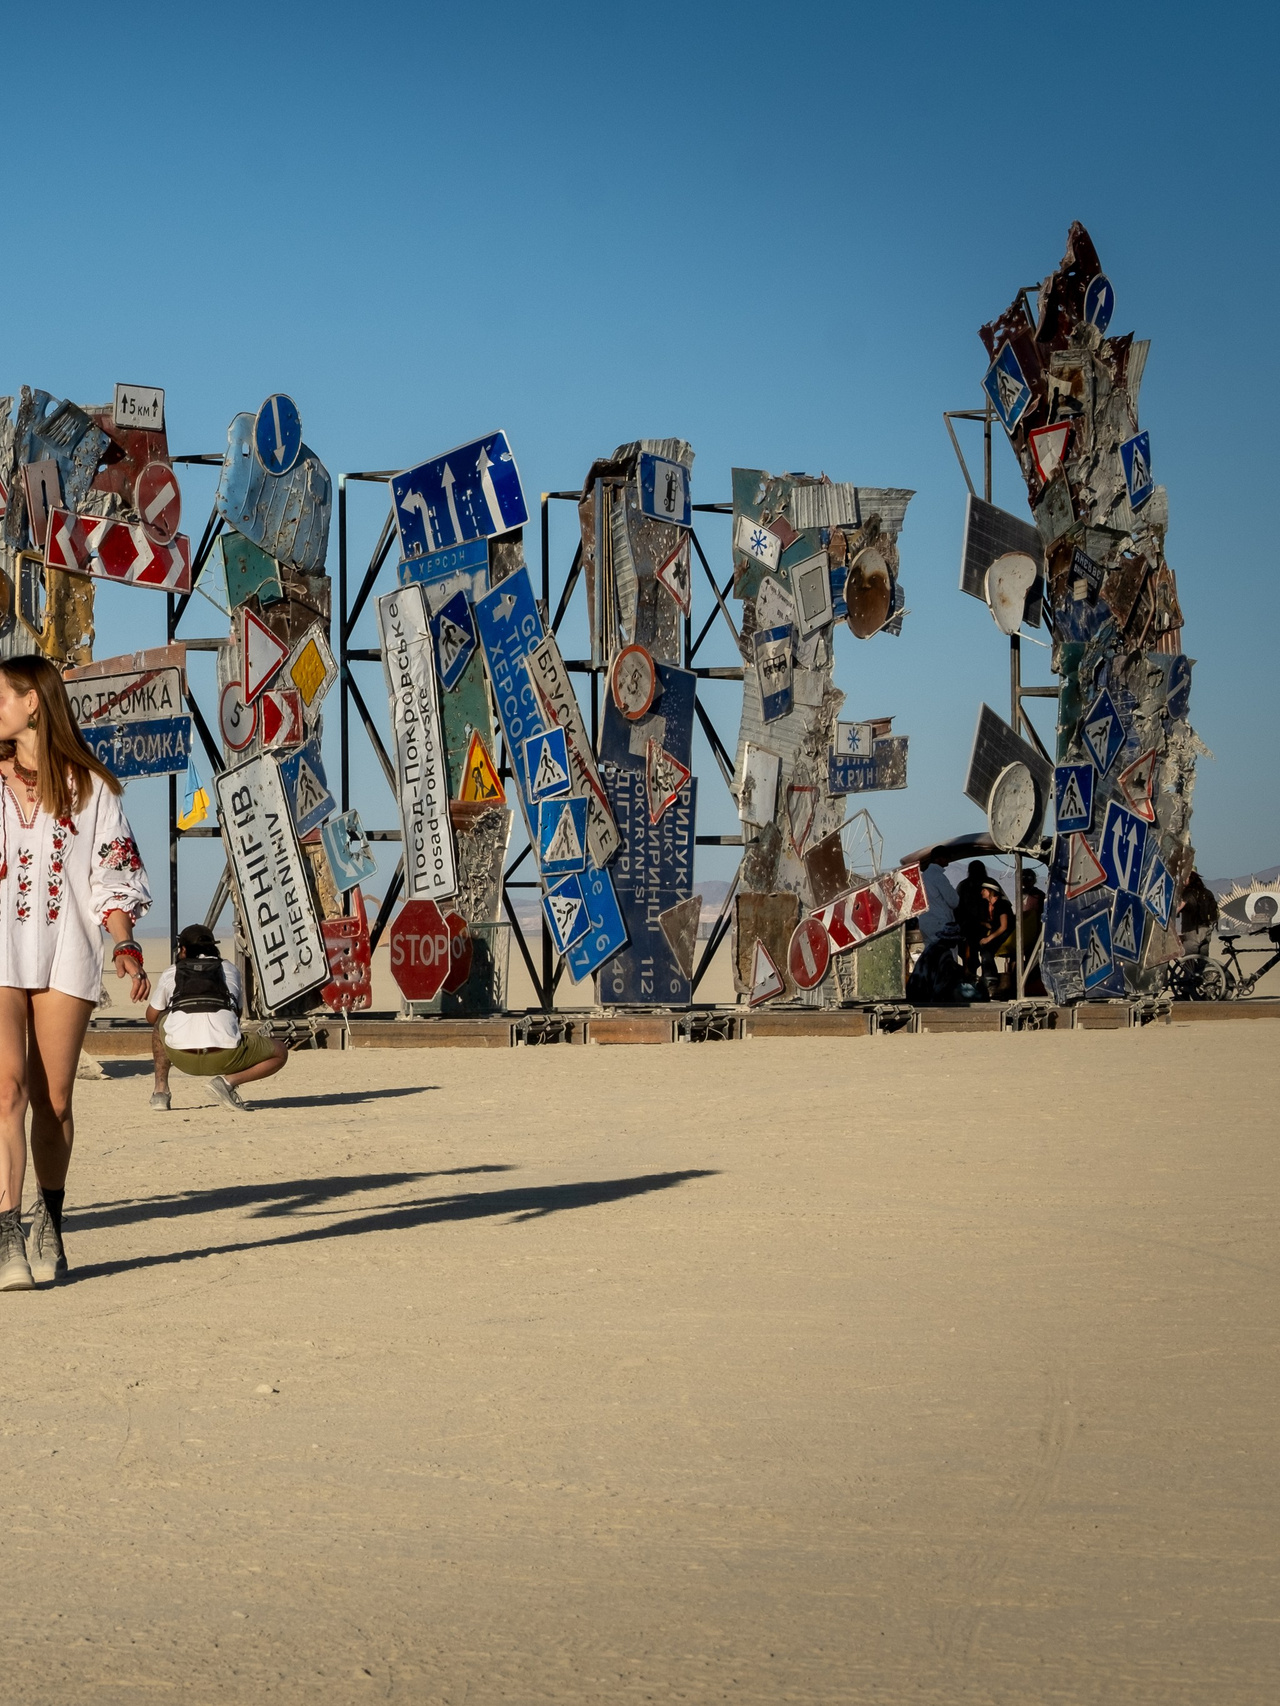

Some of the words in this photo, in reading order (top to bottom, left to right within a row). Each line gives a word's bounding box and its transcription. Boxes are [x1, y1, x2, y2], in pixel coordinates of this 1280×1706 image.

[129, 398, 136, 415] 5
[70, 683, 173, 722] ОСТРОМКА
[90, 730, 186, 765] СТРОМКА
[388, 602, 431, 893] Посад-Покровське
[231, 784, 289, 986] ЧЕРНІГІВ
[264, 812, 314, 967] CHERNIHIV
[391, 933, 448, 966] STOP
[451, 926, 469, 959] OP
[590, 914, 611, 952] 26
[640, 956, 654, 994] 112
[669, 963, 681, 994] 76
